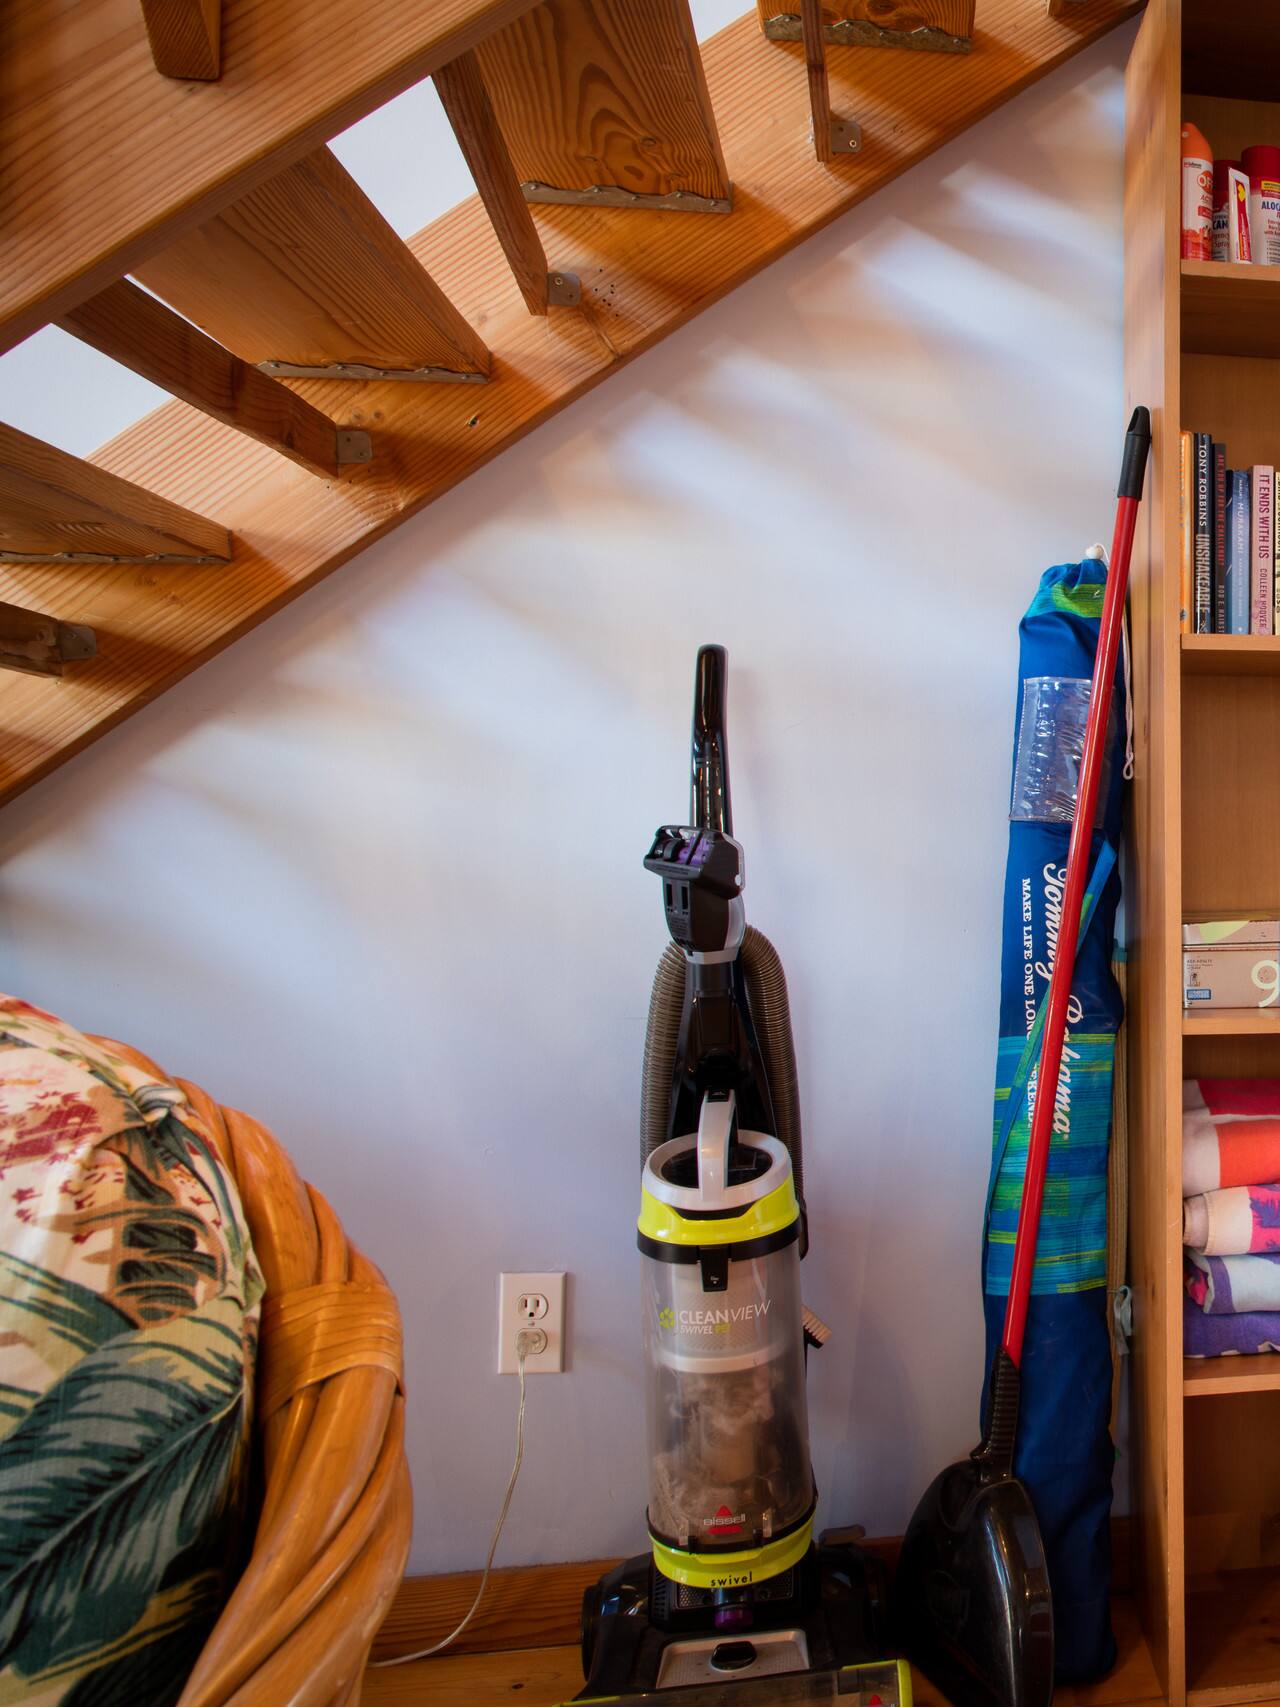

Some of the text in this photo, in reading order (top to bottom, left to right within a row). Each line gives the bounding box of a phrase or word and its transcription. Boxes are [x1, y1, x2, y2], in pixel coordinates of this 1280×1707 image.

[1199, 444, 1207, 527] TONY ROBBINS
[1258, 474, 1270, 559] IT ENDS WITH US
[1196, 533, 1211, 613] UNSHAKEABLE
[1259, 568, 1268, 628] COLLEEN HOOVER
[1022, 877, 1032, 922] MAKE
[1023, 925, 1033, 960] LIFE
[1024, 962, 1034, 995] ONE
[1025, 999, 1036, 1041] LON
[679, 1325, 713, 1336] SWIVEL
[710, 1571, 753, 1588] swivel
